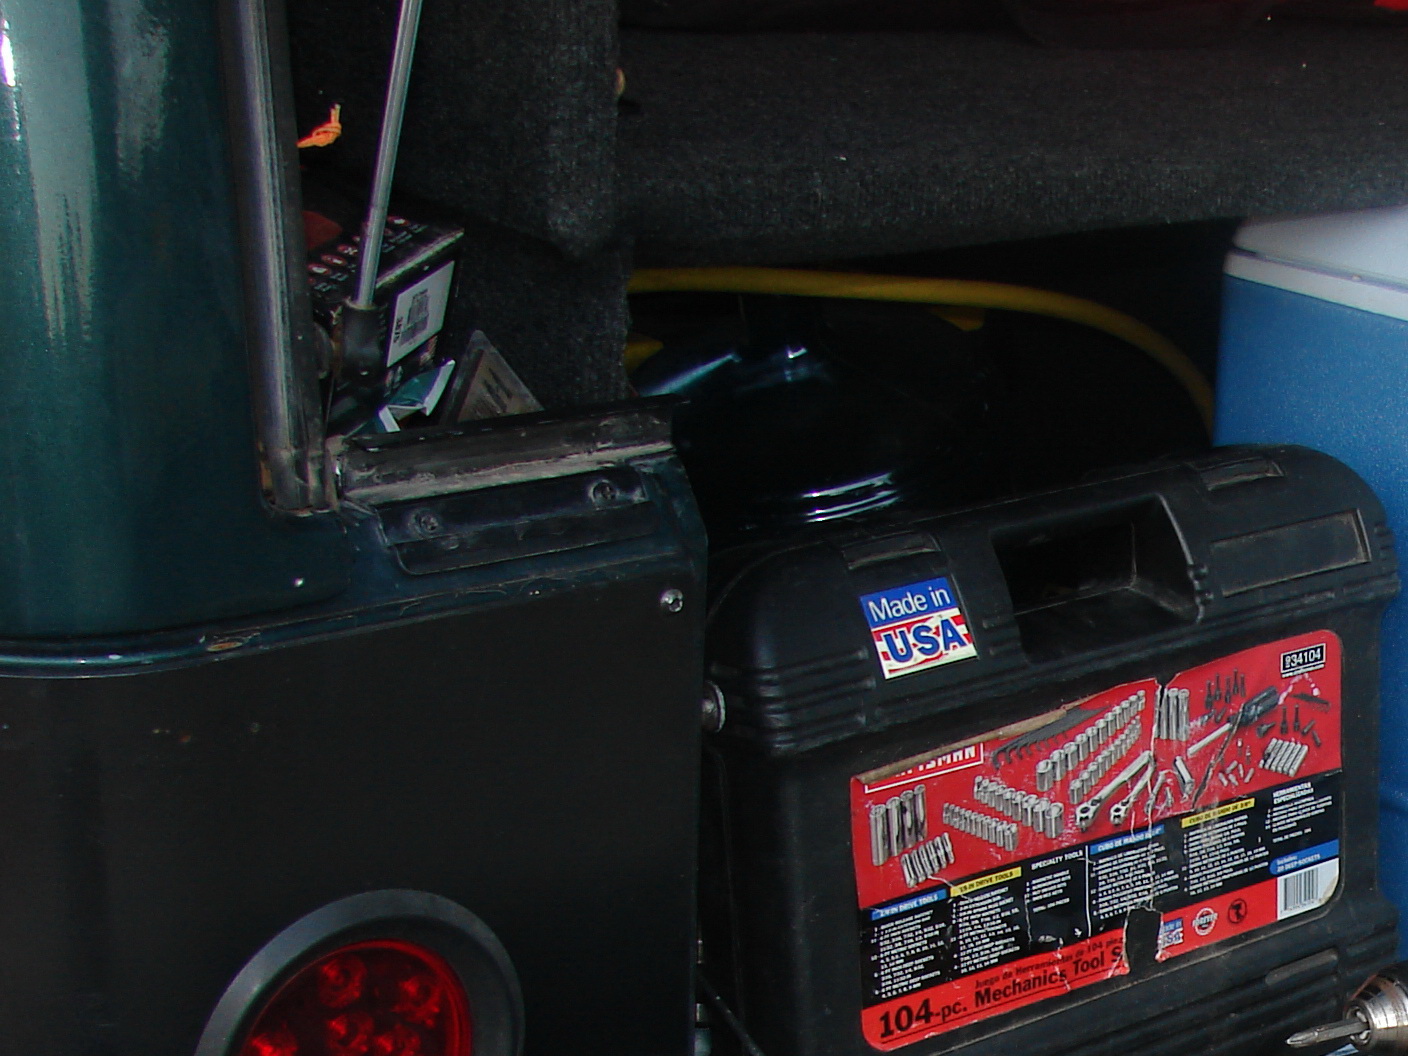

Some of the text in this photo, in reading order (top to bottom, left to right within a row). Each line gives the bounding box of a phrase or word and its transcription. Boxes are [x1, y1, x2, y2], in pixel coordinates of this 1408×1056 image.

[868, 586, 951, 622] Made in
[883, 618, 969, 663] USA
[974, 974, 1000, 989] Juego
[1001, 969, 1013, 982] de
[1086, 939, 1104, 953] 104
[879, 997, 968, 1038] 104-pc.
[974, 966, 1067, 1008] Mechanics
[1072, 953, 1105, 976] Tool
